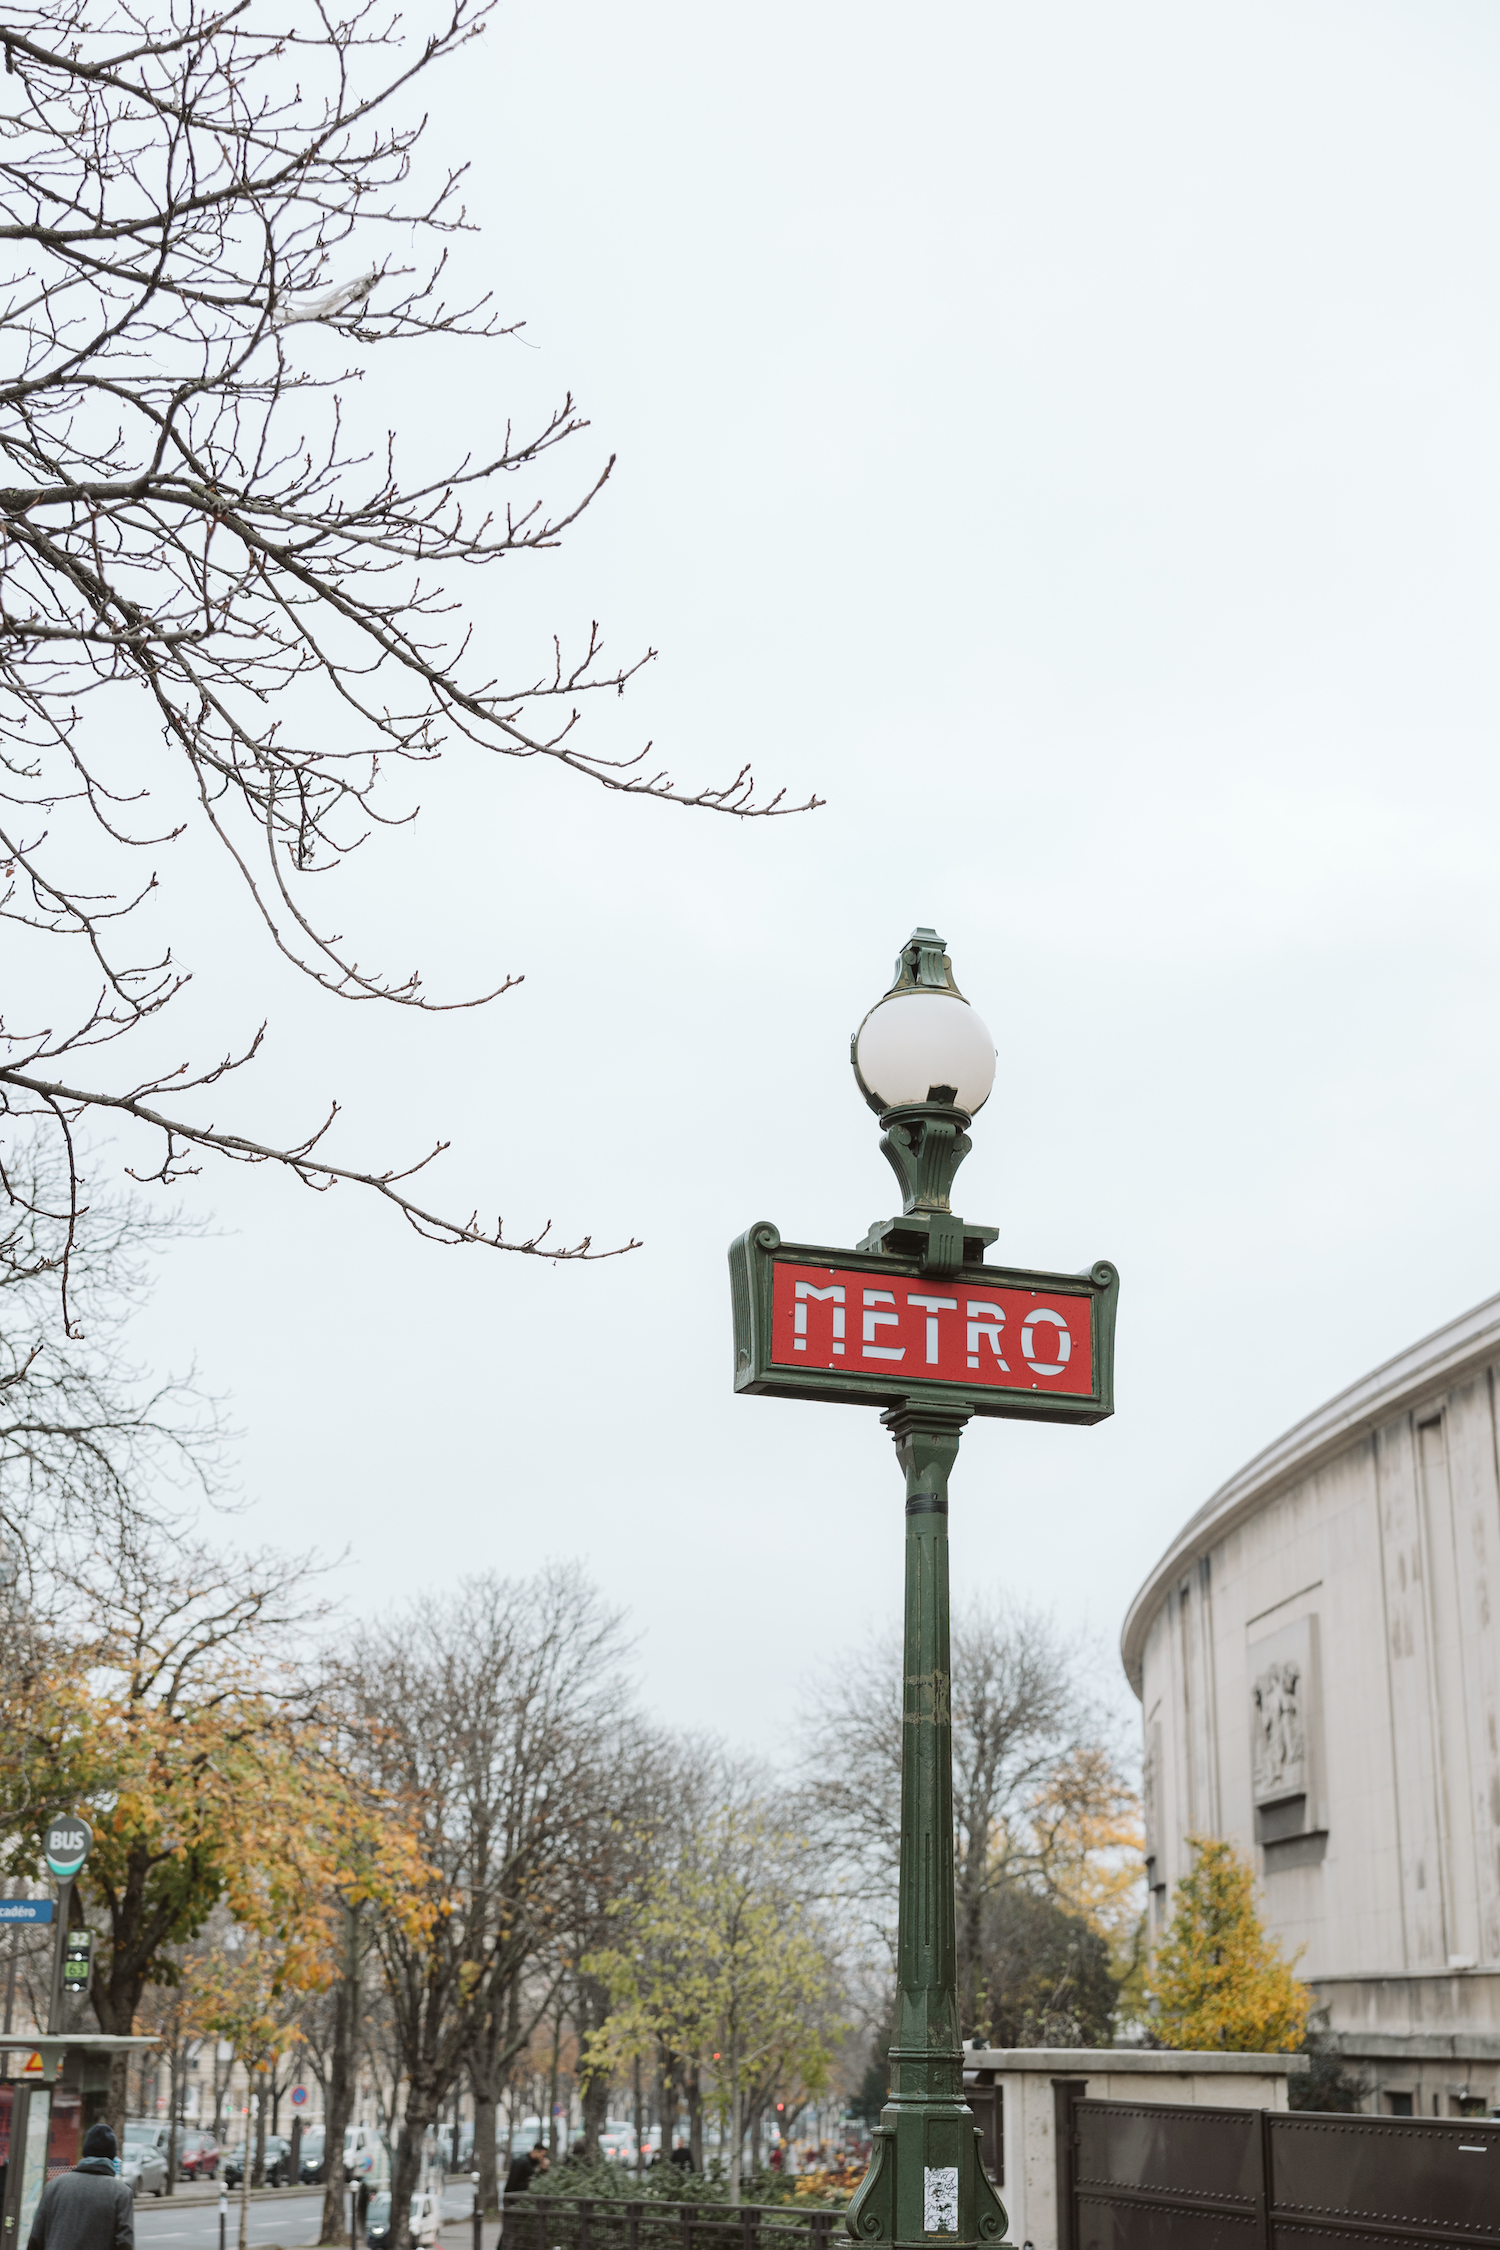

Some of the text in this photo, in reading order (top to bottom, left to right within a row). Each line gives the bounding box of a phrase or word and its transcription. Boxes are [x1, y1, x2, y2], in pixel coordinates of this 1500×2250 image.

[794, 1280, 1072, 1377] METRO
[50, 1831, 85, 1850] BUS
[69, 1932, 88, 1947] 32
[69, 1962, 84, 1976] 63
